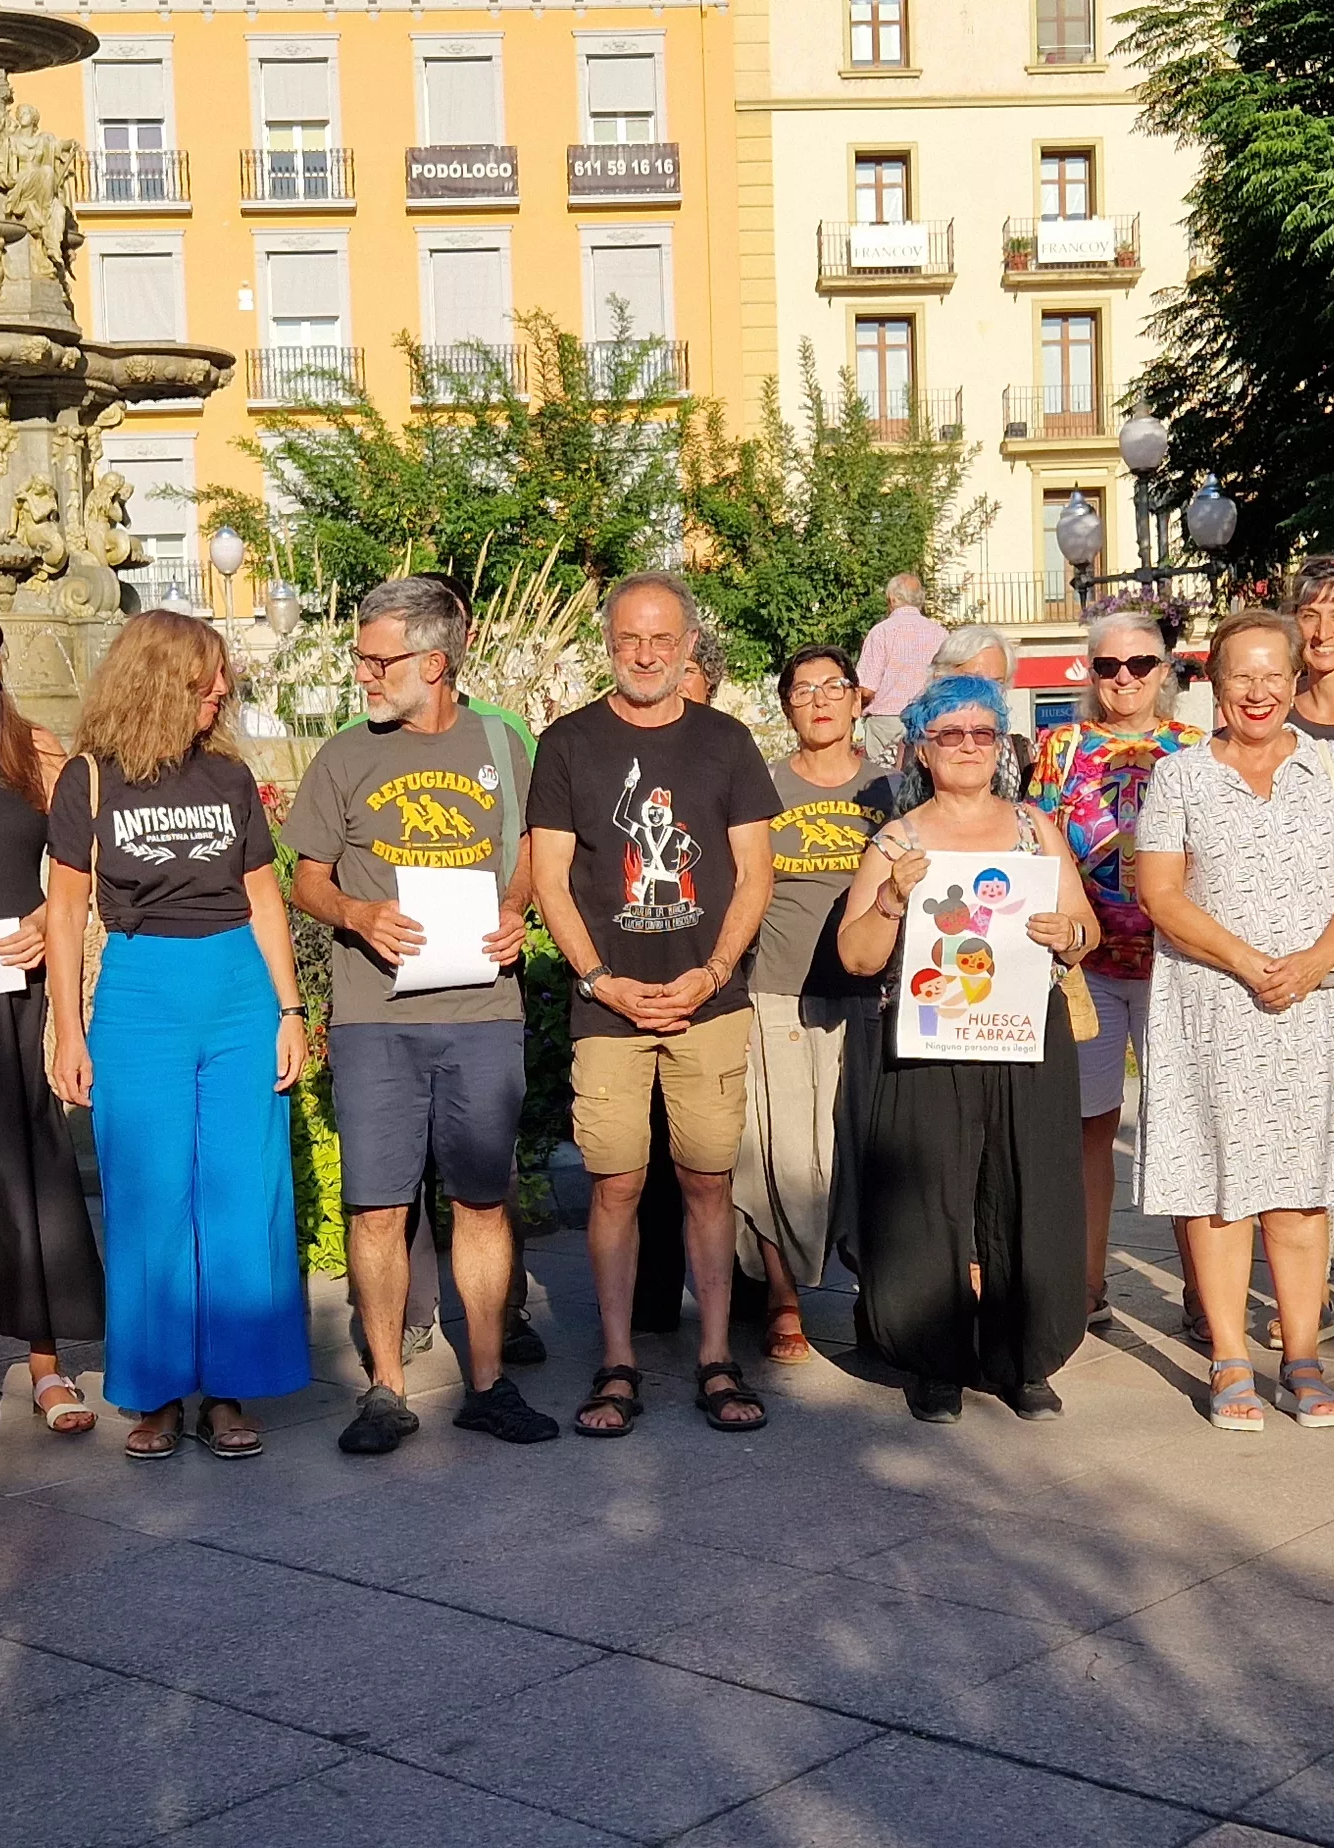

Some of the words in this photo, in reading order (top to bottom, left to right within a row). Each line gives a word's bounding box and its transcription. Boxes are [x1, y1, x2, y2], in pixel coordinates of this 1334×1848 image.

[411, 159, 513, 179] PODÓLOGO
[574, 160, 602, 177] 611
[607, 160, 627, 176] 59
[631, 159, 650, 175] 16
[654, 158, 674, 175] 16
[365, 769, 496, 812] REFUGIADXS
[112, 803, 237, 847] ANTISIONISTA
[146, 832, 189, 843] PALESTINA
[190, 831, 215, 840] LIBRE
[371, 837, 494, 868] BIENVENIDXS
[772, 853, 861, 873] BIENVENI
[968, 1013, 1033, 1028] HUESCA
[954, 1027, 970, 1040] TE
[975, 1028, 1037, 1042] ABRAZA
[925, 1041, 962, 1053] Ninguna
[964, 1044, 999, 1053] persona
[1013, 1043, 1037, 1054] ilegal
